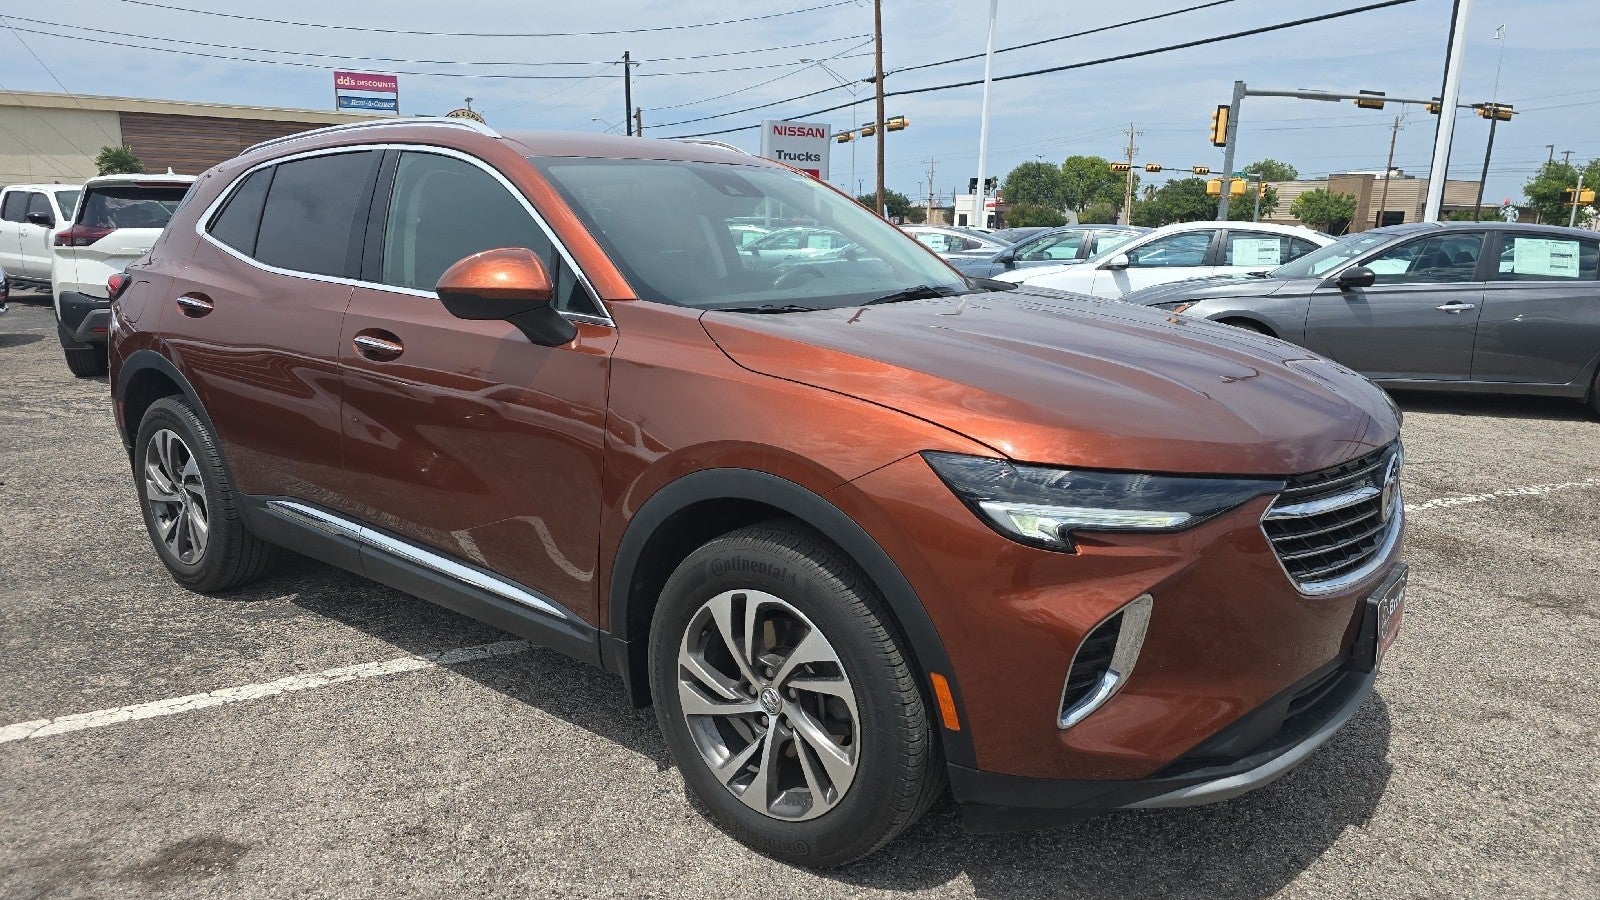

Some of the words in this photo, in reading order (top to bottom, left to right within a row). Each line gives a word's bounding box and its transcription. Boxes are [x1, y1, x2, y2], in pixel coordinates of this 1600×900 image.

[337, 76, 355, 86] dd's
[357, 80, 396, 88] DISCOUNTS
[773, 125, 825, 139] NISSAN
[775, 150, 821, 162] Trucks
